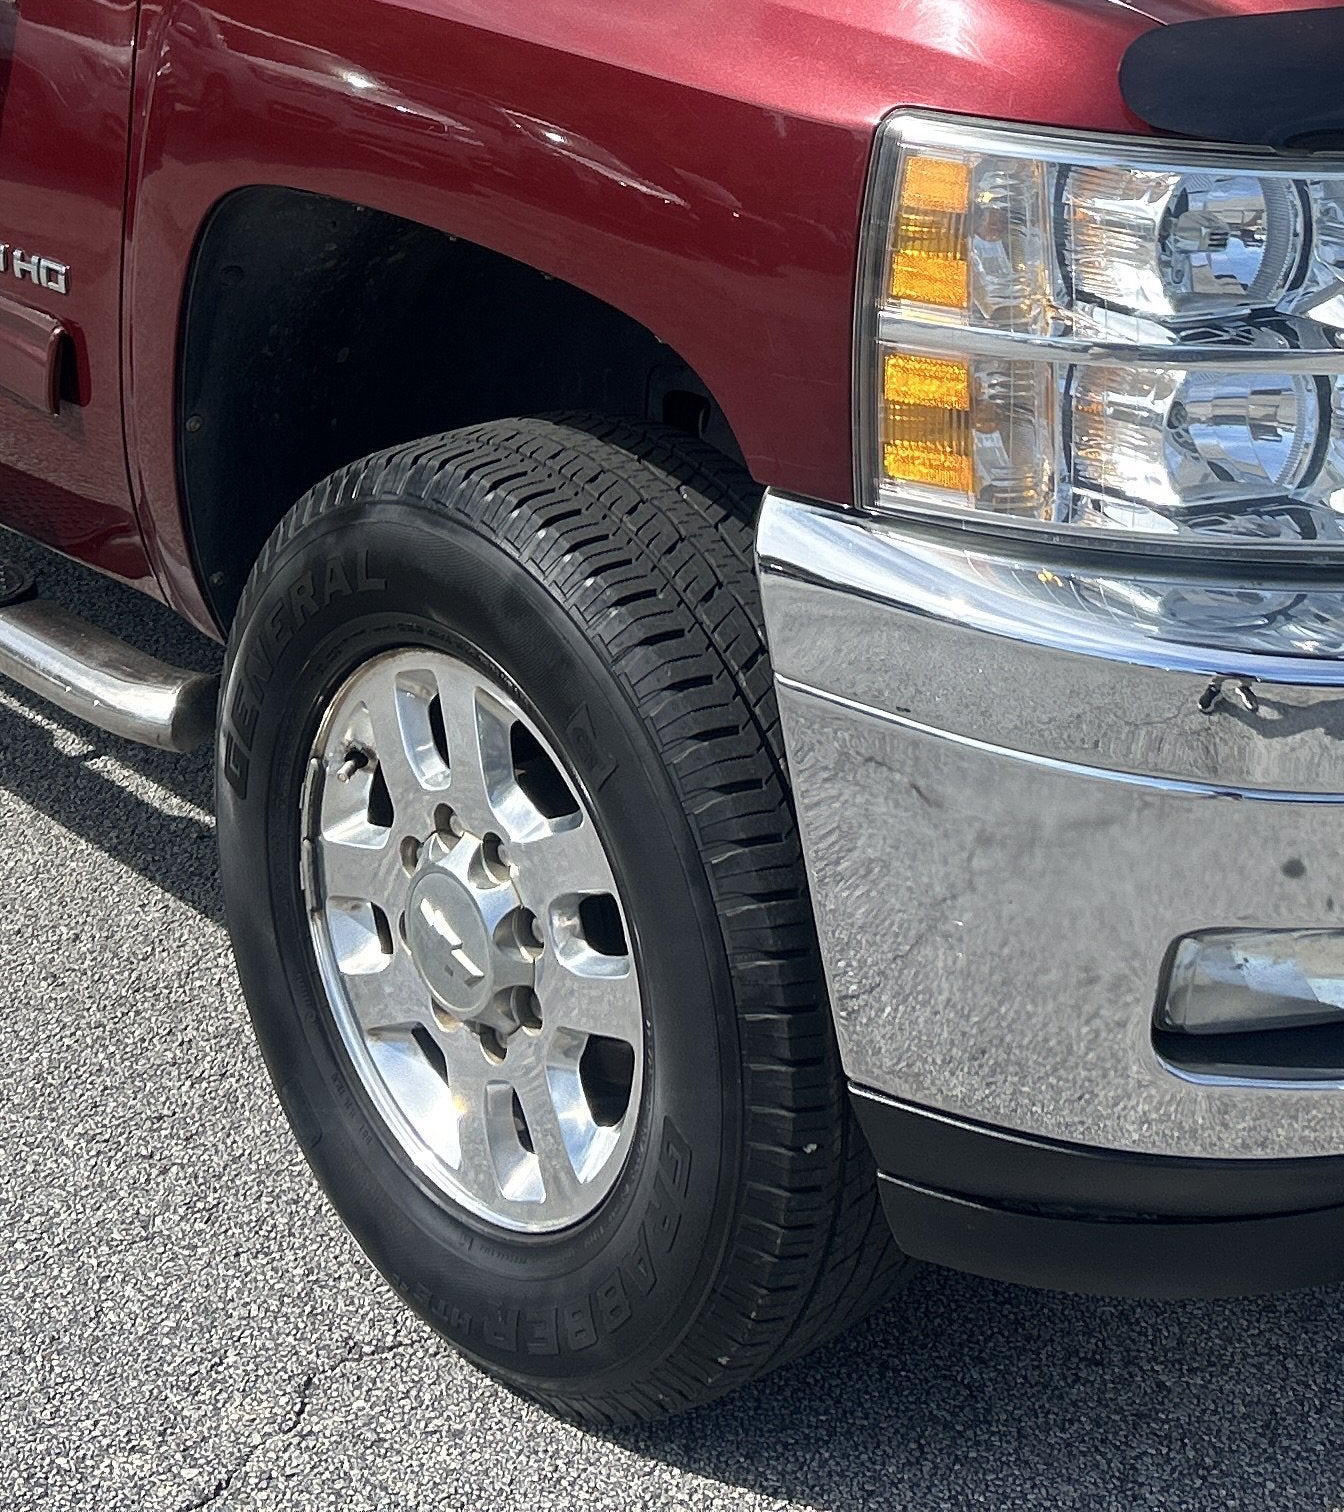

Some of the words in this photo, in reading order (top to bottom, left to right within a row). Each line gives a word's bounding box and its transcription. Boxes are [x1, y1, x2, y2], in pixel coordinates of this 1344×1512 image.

[13, 248, 69, 295] HD
[223, 546, 387, 800] GENERAL
[483, 1114, 694, 1356] GRABBER
